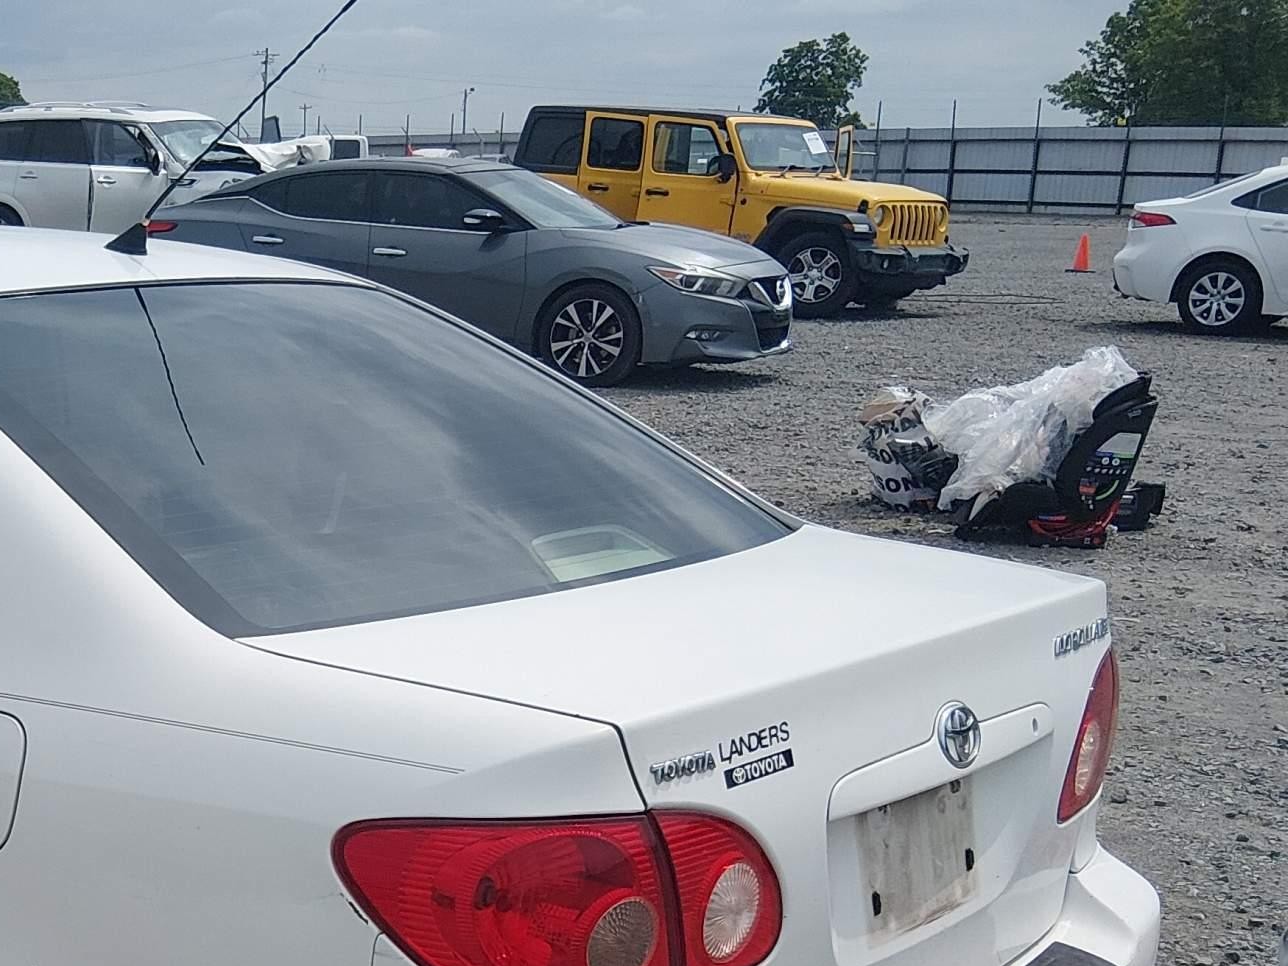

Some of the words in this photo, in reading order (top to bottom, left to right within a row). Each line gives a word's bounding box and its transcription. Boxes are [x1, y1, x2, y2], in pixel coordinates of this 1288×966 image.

[718, 721, 790, 764] LANDERS
[649, 750, 717, 785] TOYOTA
[744, 754, 788, 780] TOYOTA
